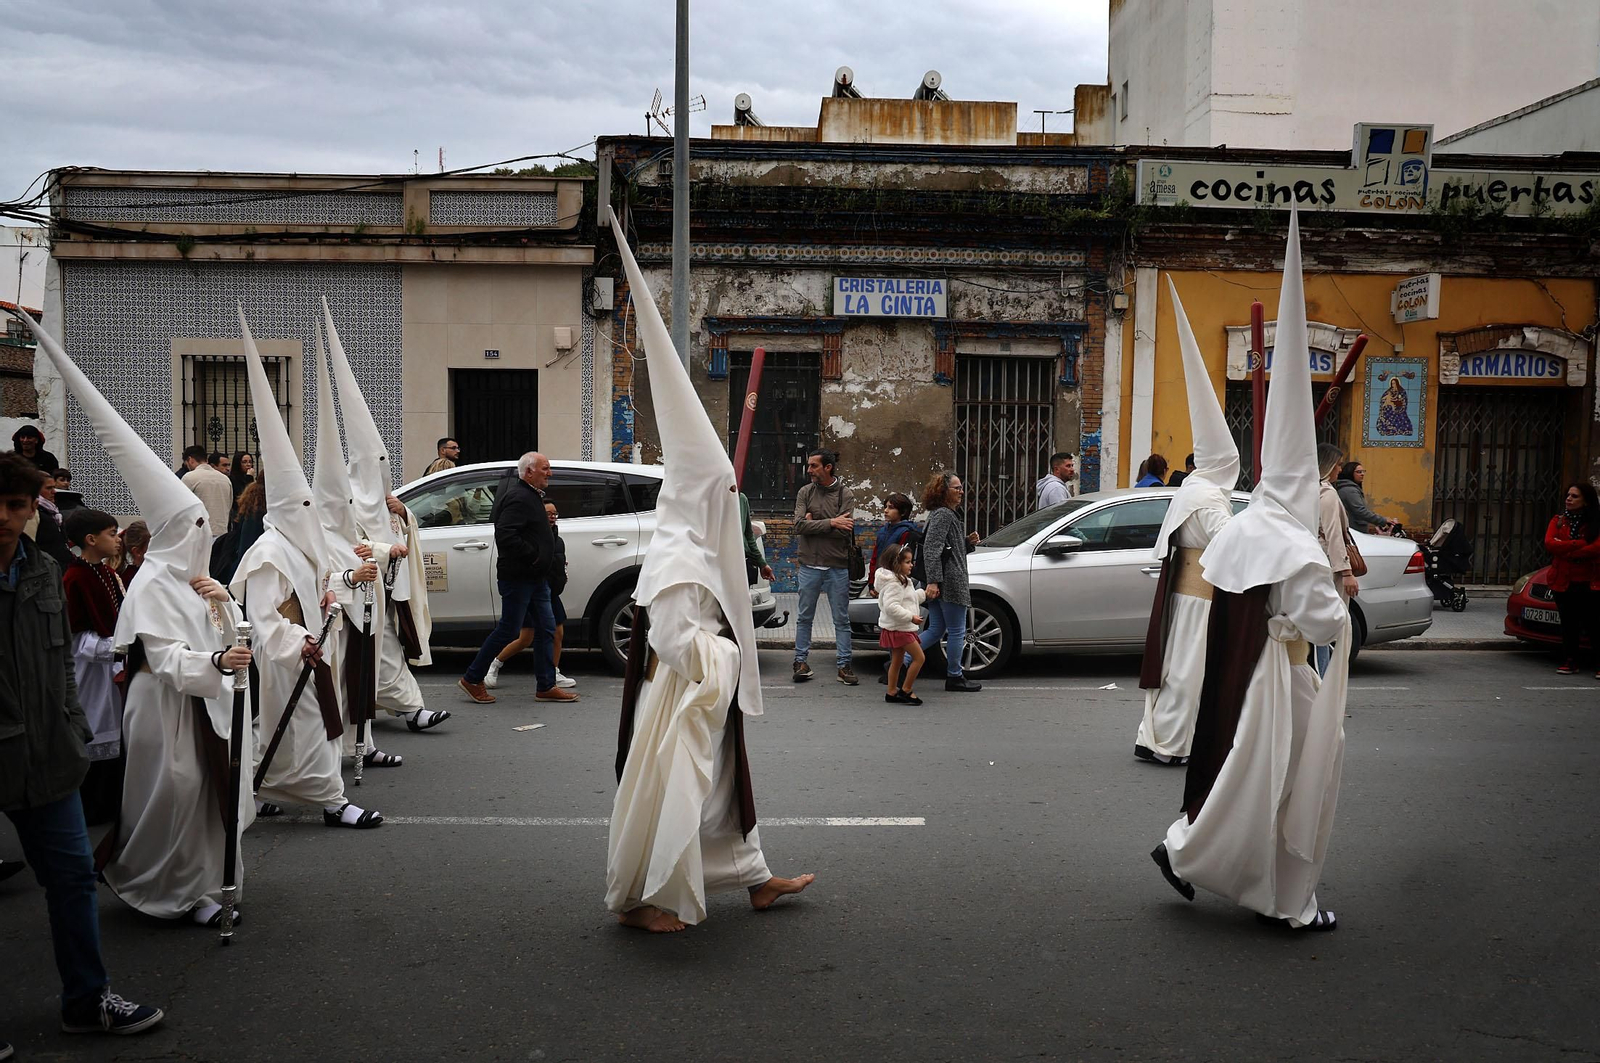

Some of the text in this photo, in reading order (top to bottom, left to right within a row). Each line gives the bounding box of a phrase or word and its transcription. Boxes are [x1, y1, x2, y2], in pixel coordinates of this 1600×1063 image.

[1150, 181, 1176, 194] amesa
[1190, 171, 1336, 204] cocinas
[1440, 176, 1594, 210] puertas
[839, 278, 943, 295] CRISTALERIA
[1399, 277, 1429, 291] puertas
[1400, 287, 1427, 298] cocinas
[845, 294, 936, 315] LA CINTA
[1459, 354, 1560, 377] ARMARIOS
[1525, 609, 1543, 620] 0728
